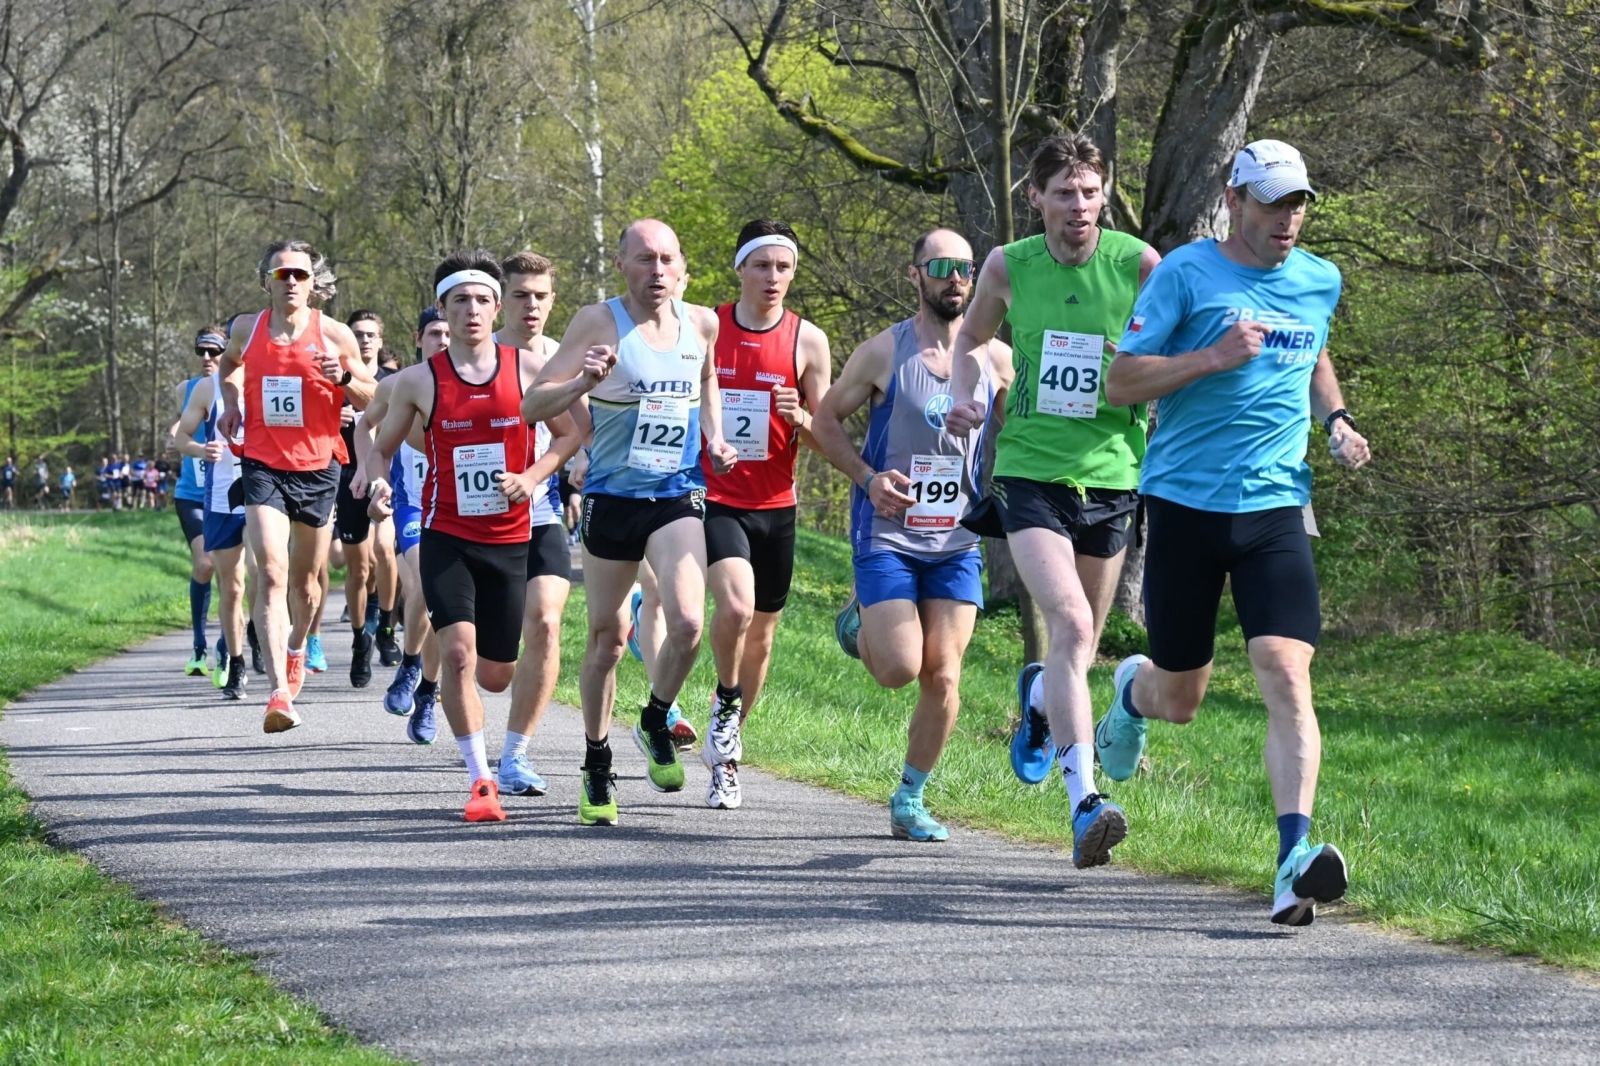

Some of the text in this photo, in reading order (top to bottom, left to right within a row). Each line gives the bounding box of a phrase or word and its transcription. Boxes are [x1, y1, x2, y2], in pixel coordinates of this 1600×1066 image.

[1050, 340, 1069, 348] CUP
[1263, 330, 1316, 350] NNER
[1277, 351, 1314, 364] TEAM
[756, 371, 786, 382] MARATON
[1040, 365, 1098, 393] 403
[271, 396, 295, 412] 16
[490, 416, 520, 424] MARATON
[735, 416, 751, 437] 2
[638, 422, 685, 448] 122
[457, 469, 505, 493] 109
[912, 481, 959, 504] 199
